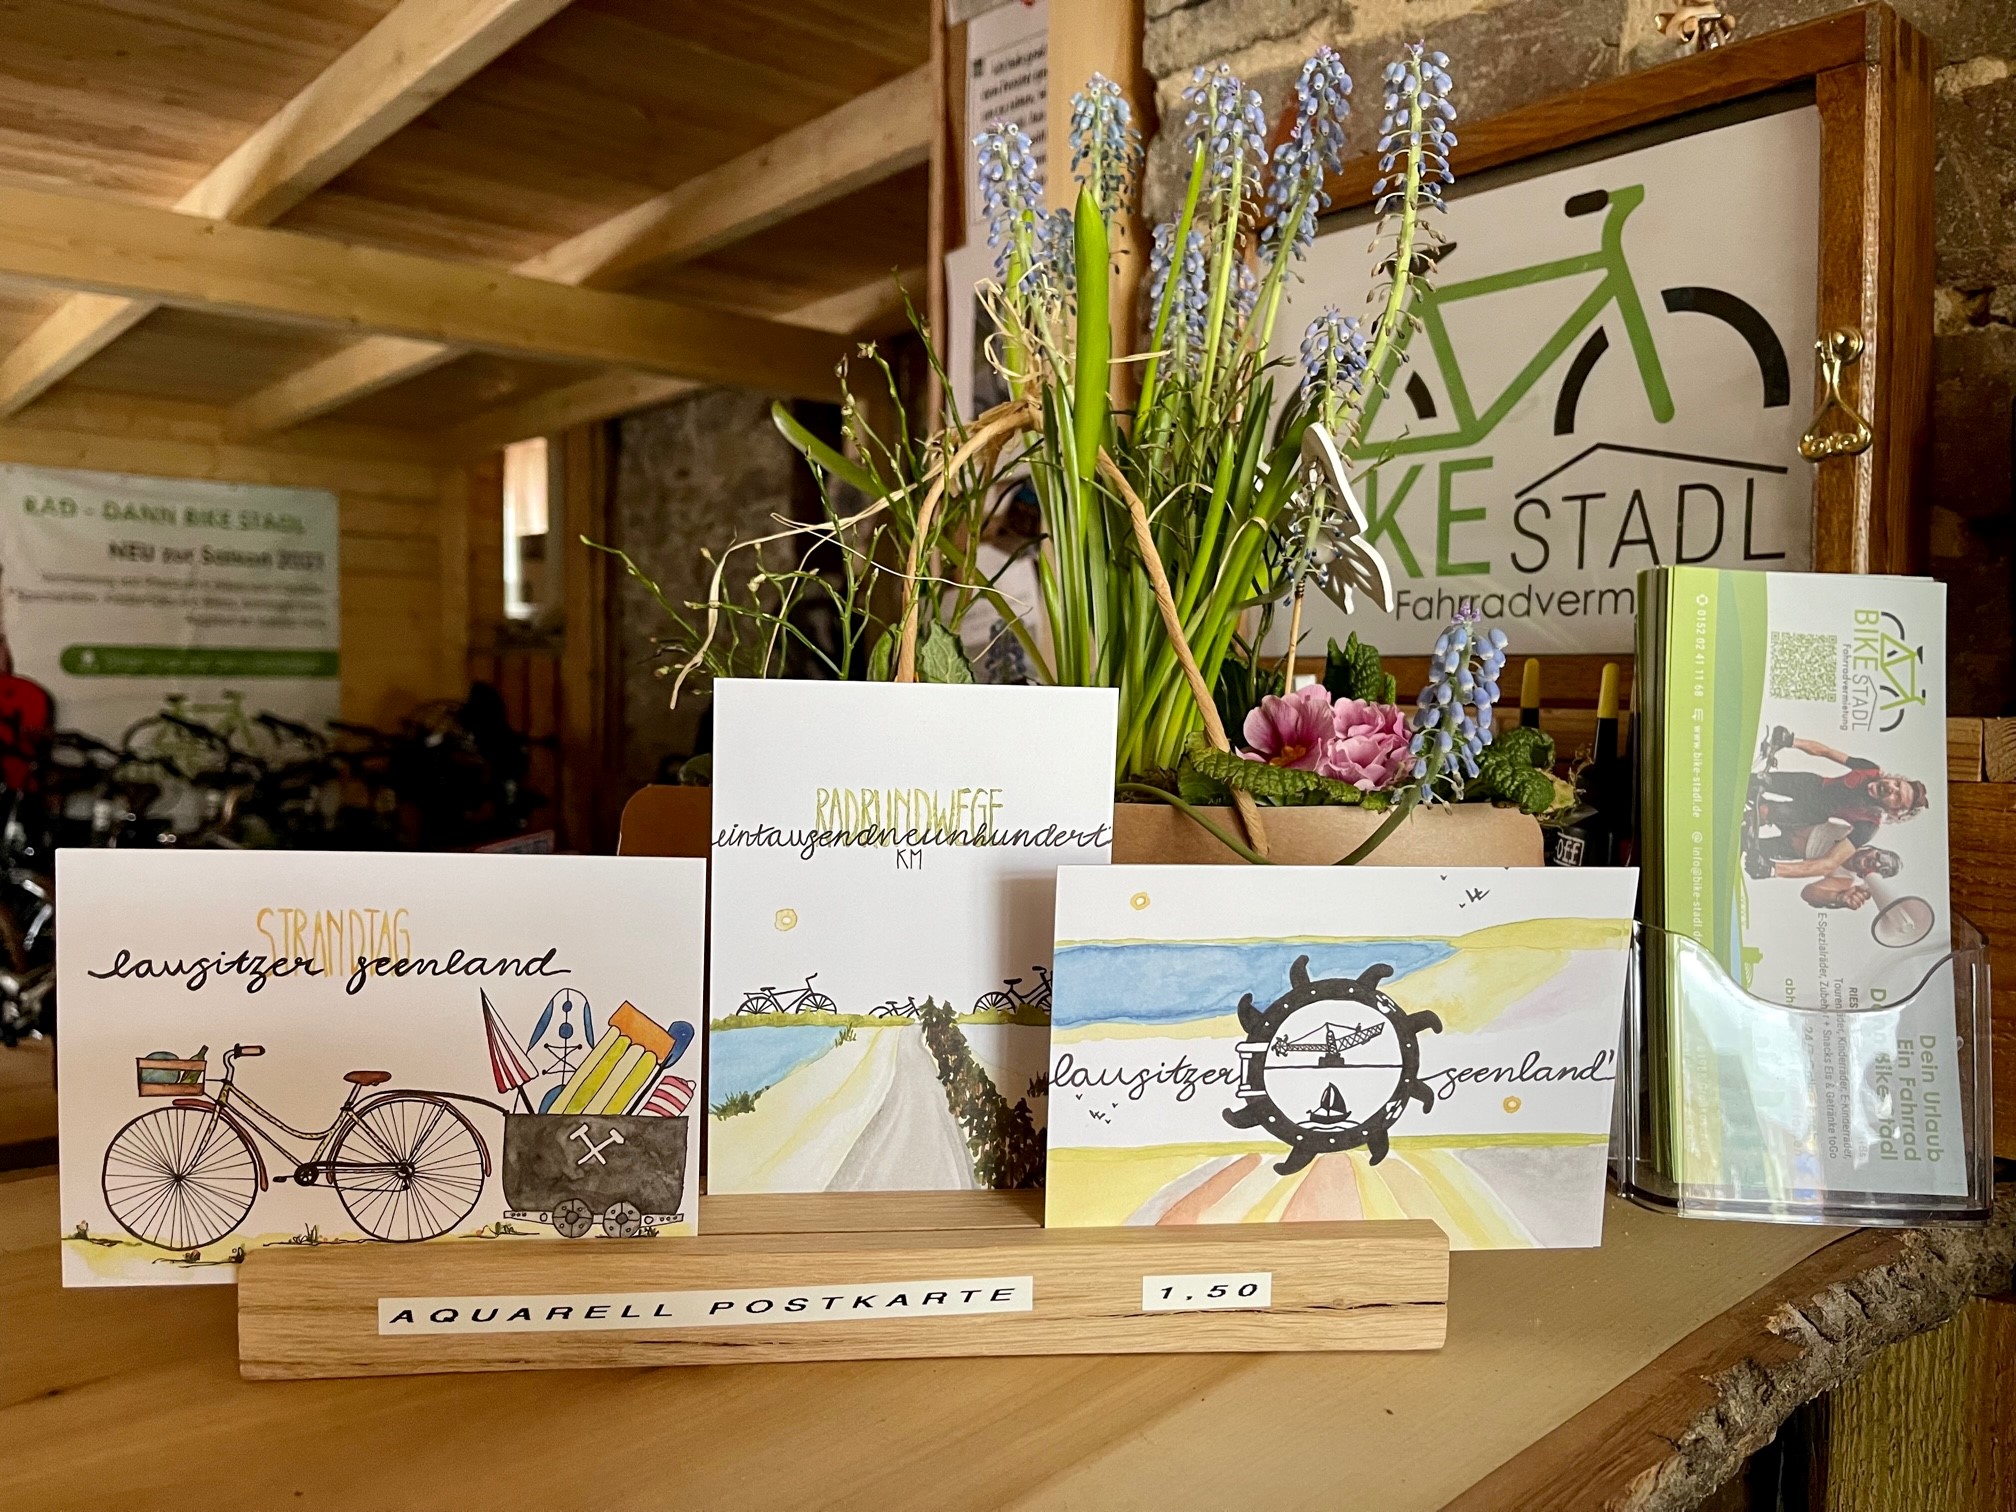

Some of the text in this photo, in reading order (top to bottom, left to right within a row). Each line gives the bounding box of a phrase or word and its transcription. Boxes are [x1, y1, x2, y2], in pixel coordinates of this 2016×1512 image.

[1364, 456, 1786, 578] KE STADL
[1396, 583, 1635, 622] Fahrradverm
[1694, 609, 1706, 697] 0152 02 41 11 68
[1852, 609, 1880, 731] BIKE STADL
[1840, 643, 1852, 731] Fahrradvermietung
[1691, 726, 1703, 818] www.bike-stadl.de
[814, 787, 1004, 850] RADRUNDWEGE
[896, 848, 922, 871] KM
[257, 907, 412, 979] STRANDTAG
[1816, 912, 1829, 979] E-Spezialräder,
[1819, 981, 1831, 1018] Zubehr
[1834, 978, 1848, 1034] Tourenäder,
[1848, 986, 1859, 1009] RIES
[1822, 1029, 1834, 1063] Snacks
[1824, 1066, 1835, 1080] Eis
[1836, 1037, 1849, 1093] Kinderräder,
[1826, 1092, 1838, 1133] Getränke
[1896, 1039, 1922, 1161] Ein Fahrrad
[1920, 1034, 1945, 1162] Dein Urlaub
[1828, 1136, 1839, 1159] toGo
[1878, 1114, 1899, 1161] tadl
[389, 1303, 674, 1325] AQUARELL
[708, 1287, 1016, 1316] POSTKARTE
